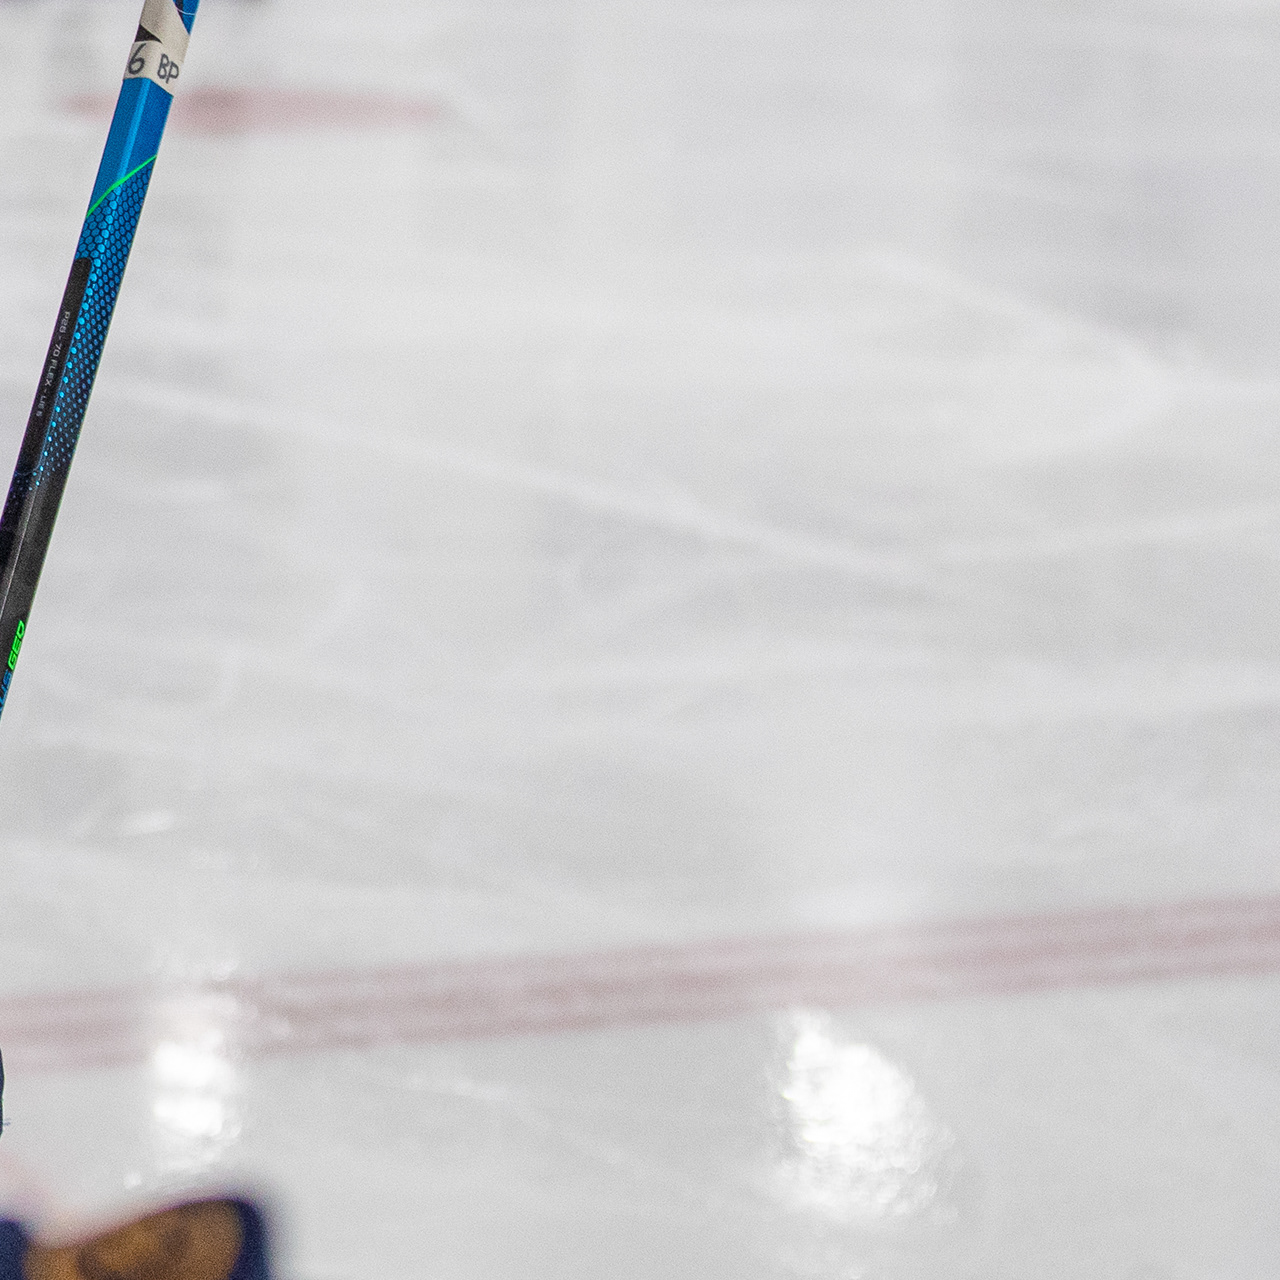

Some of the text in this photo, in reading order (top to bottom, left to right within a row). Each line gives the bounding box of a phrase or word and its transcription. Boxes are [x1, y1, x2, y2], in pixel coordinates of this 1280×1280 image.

[128, 43, 179, 84] 6 BP
[44, 359, 58, 387] FLEX
[7, 619, 26, 670] GEO
